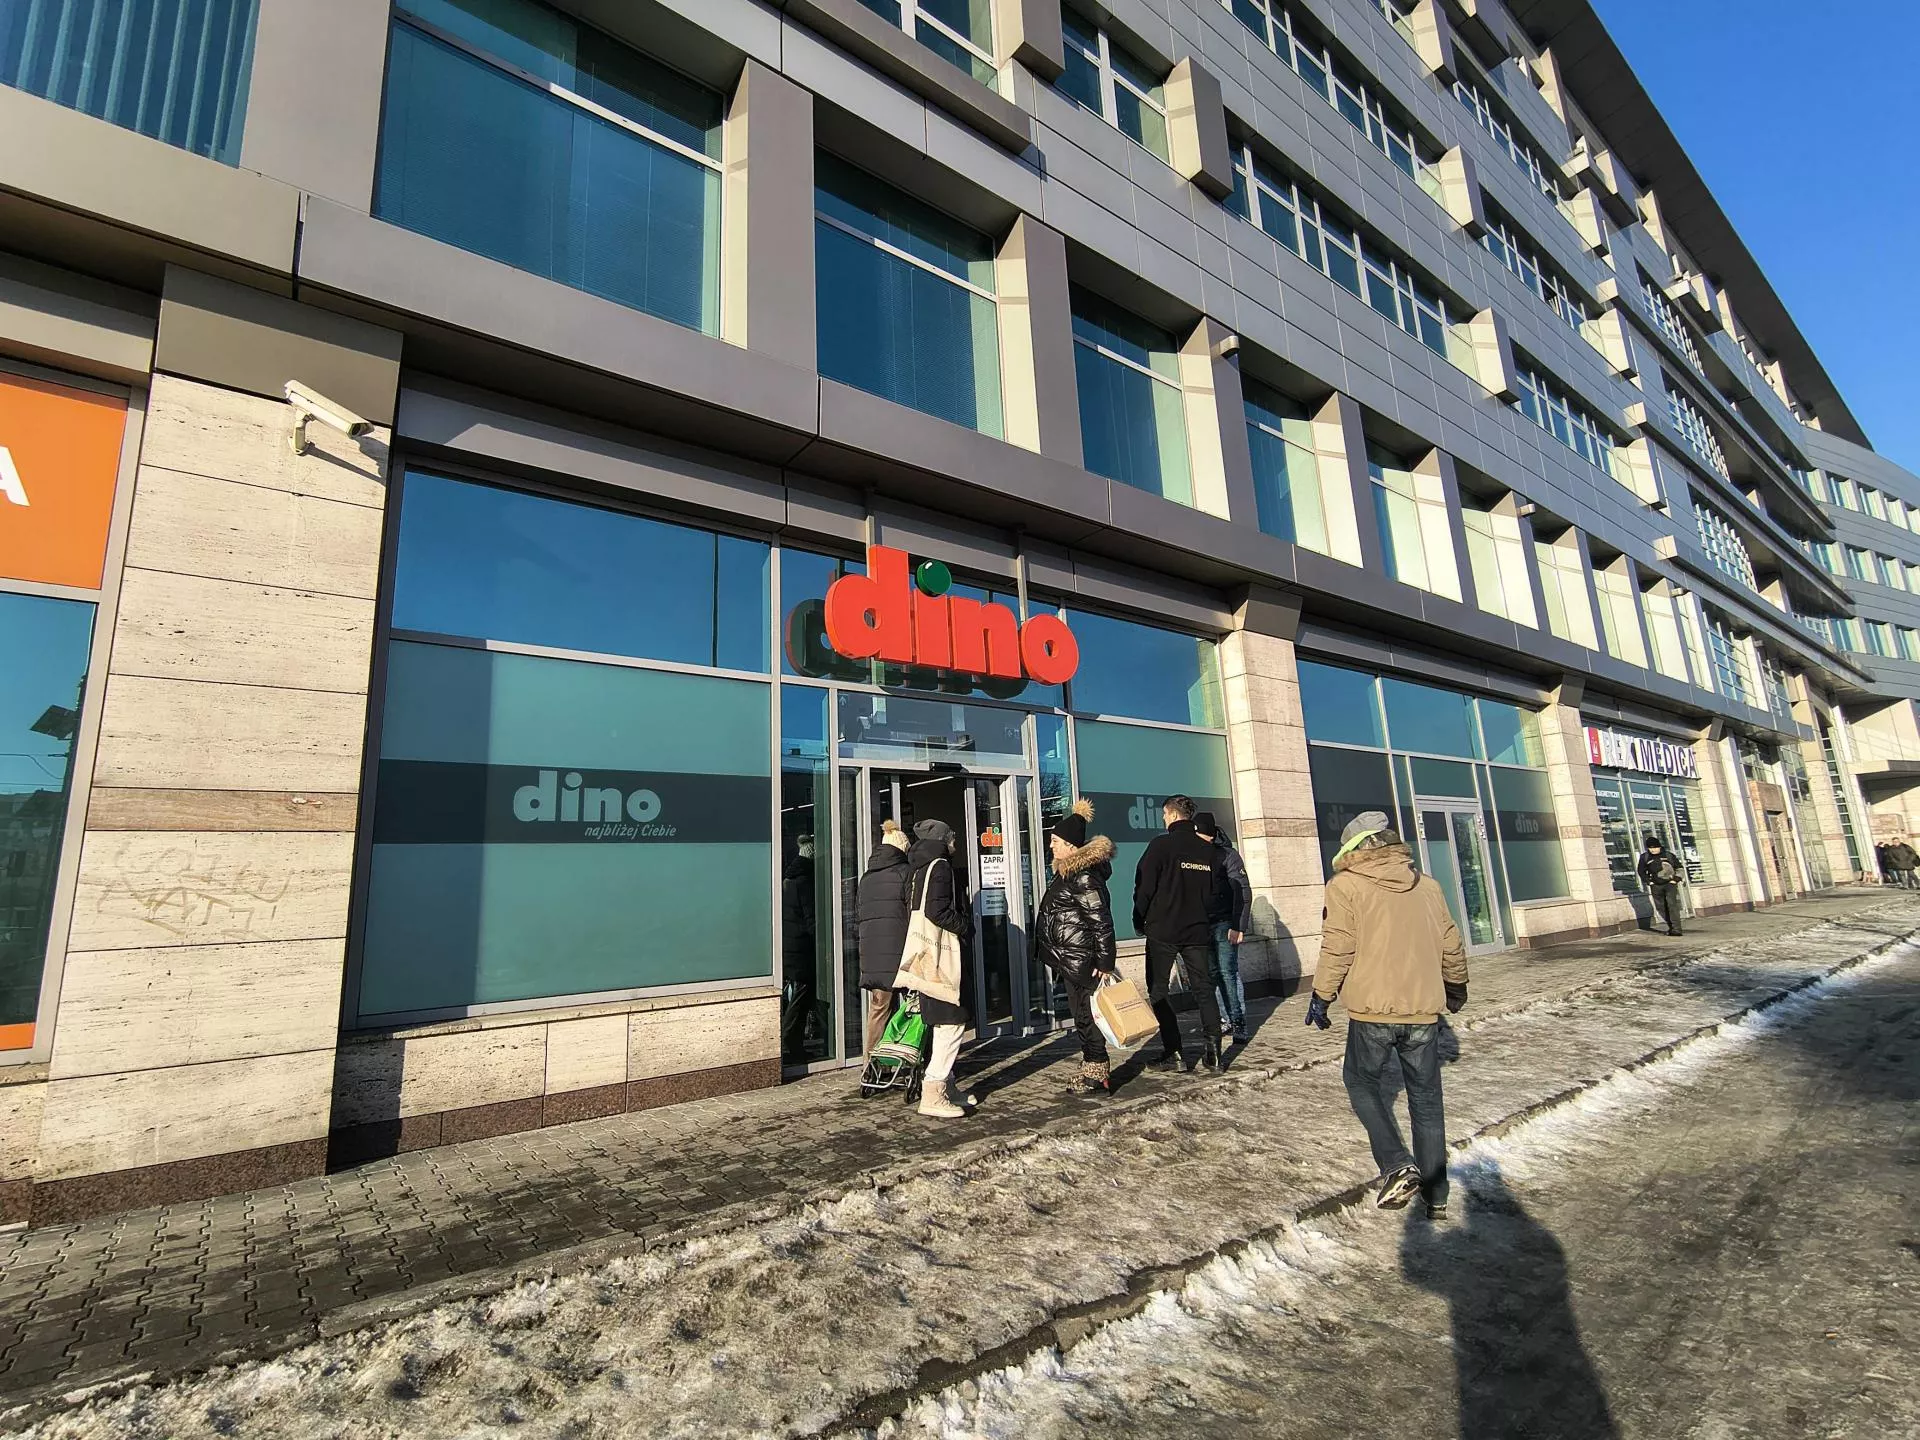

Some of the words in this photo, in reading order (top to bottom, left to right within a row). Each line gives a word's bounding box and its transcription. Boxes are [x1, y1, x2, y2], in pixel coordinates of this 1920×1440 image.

[824, 544, 1079, 686] dino
[1635, 738, 1698, 779] MEDICA
[513, 770, 662, 823] dino
[584, 824, 638, 840] najbliżej
[641, 824, 677, 837] Ciebie
[1515, 812, 1539, 833] dino
[1181, 862, 1211, 872] OCHRONA
